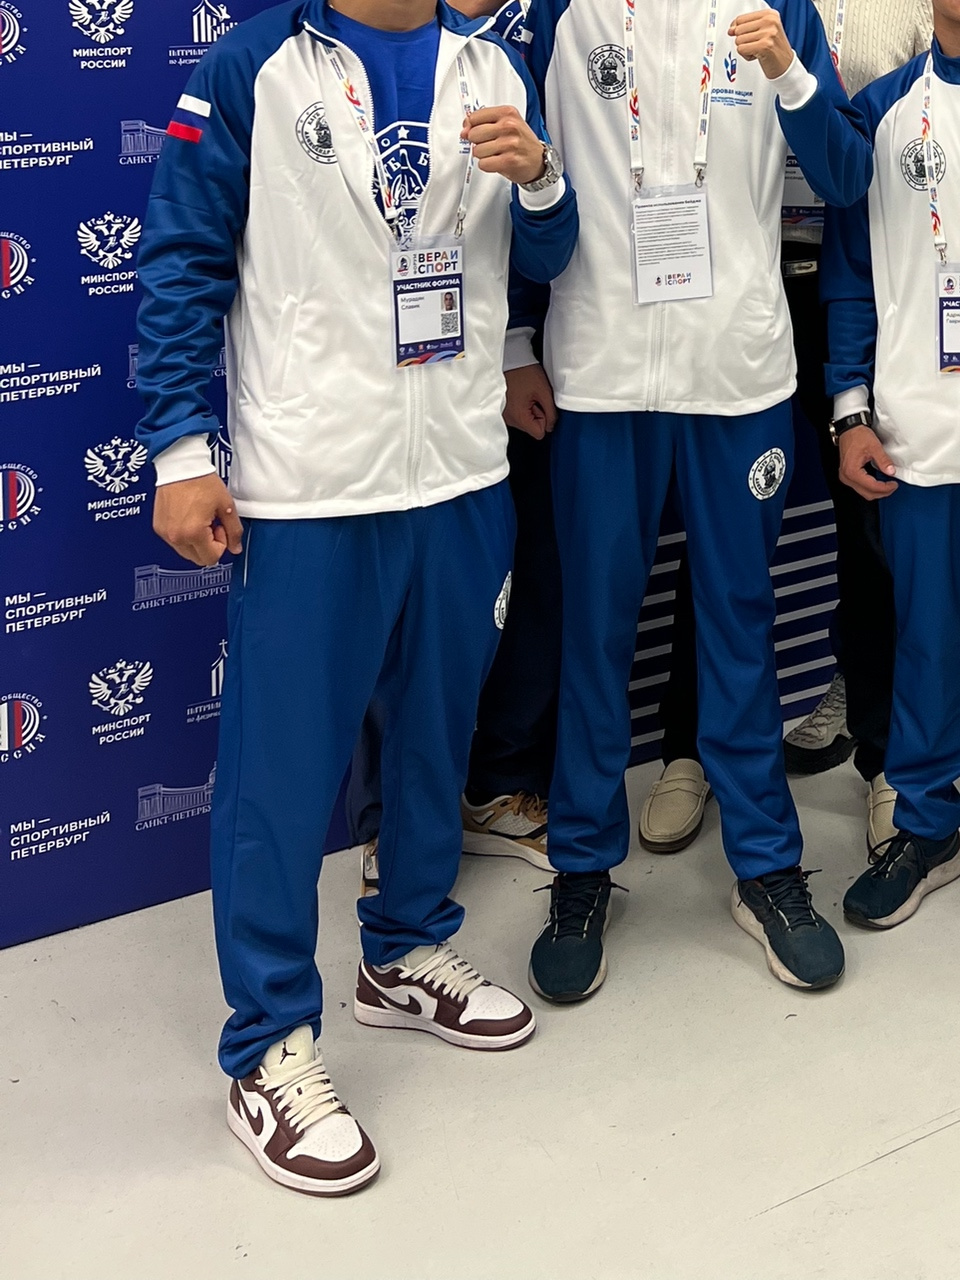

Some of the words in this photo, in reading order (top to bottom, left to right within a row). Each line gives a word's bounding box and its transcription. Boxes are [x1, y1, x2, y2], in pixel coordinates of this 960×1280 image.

[73, 46, 133, 58] МИНСПОРТ
[80, 59, 126, 70] РОССИИ
[0, 137, 94, 156] ПОРТИВНЫЙ
[0, 155, 73, 170] ЕТЕРБУРГ
[418, 250, 449, 263] ВЕРА
[450, 249, 458, 260] И
[417, 261, 458, 274] СПОРТ
[88, 283, 134, 296] РОССИИ
[396, 280, 432, 291] УЧАСТНИК
[431, 278, 461, 287] ФОРУМА
[667, 278, 692, 286] СПОРТ
[0, 364, 101, 389] СПОРТИВНЫЙ
[0, 382, 81, 403] ПЕТЕРБУРГ
[87, 493, 147, 511] МИНСПОРТ
[95, 506, 140, 522] РОССИИ
[5, 592, 31, 607] МЫ
[5, 588, 107, 620] СПОРТИВНЫЙ
[5, 608, 87, 634] ПЕТЕРБУРГ
[92, 713, 152, 735] МИНСПОРТ
[99, 726, 144, 745] РОССИИ
[10, 818, 36, 835] МЫ
[10, 810, 110, 847] СПОРТИВНЫЙ
[11, 831, 90, 861] ПЕТЕРБУРГ
